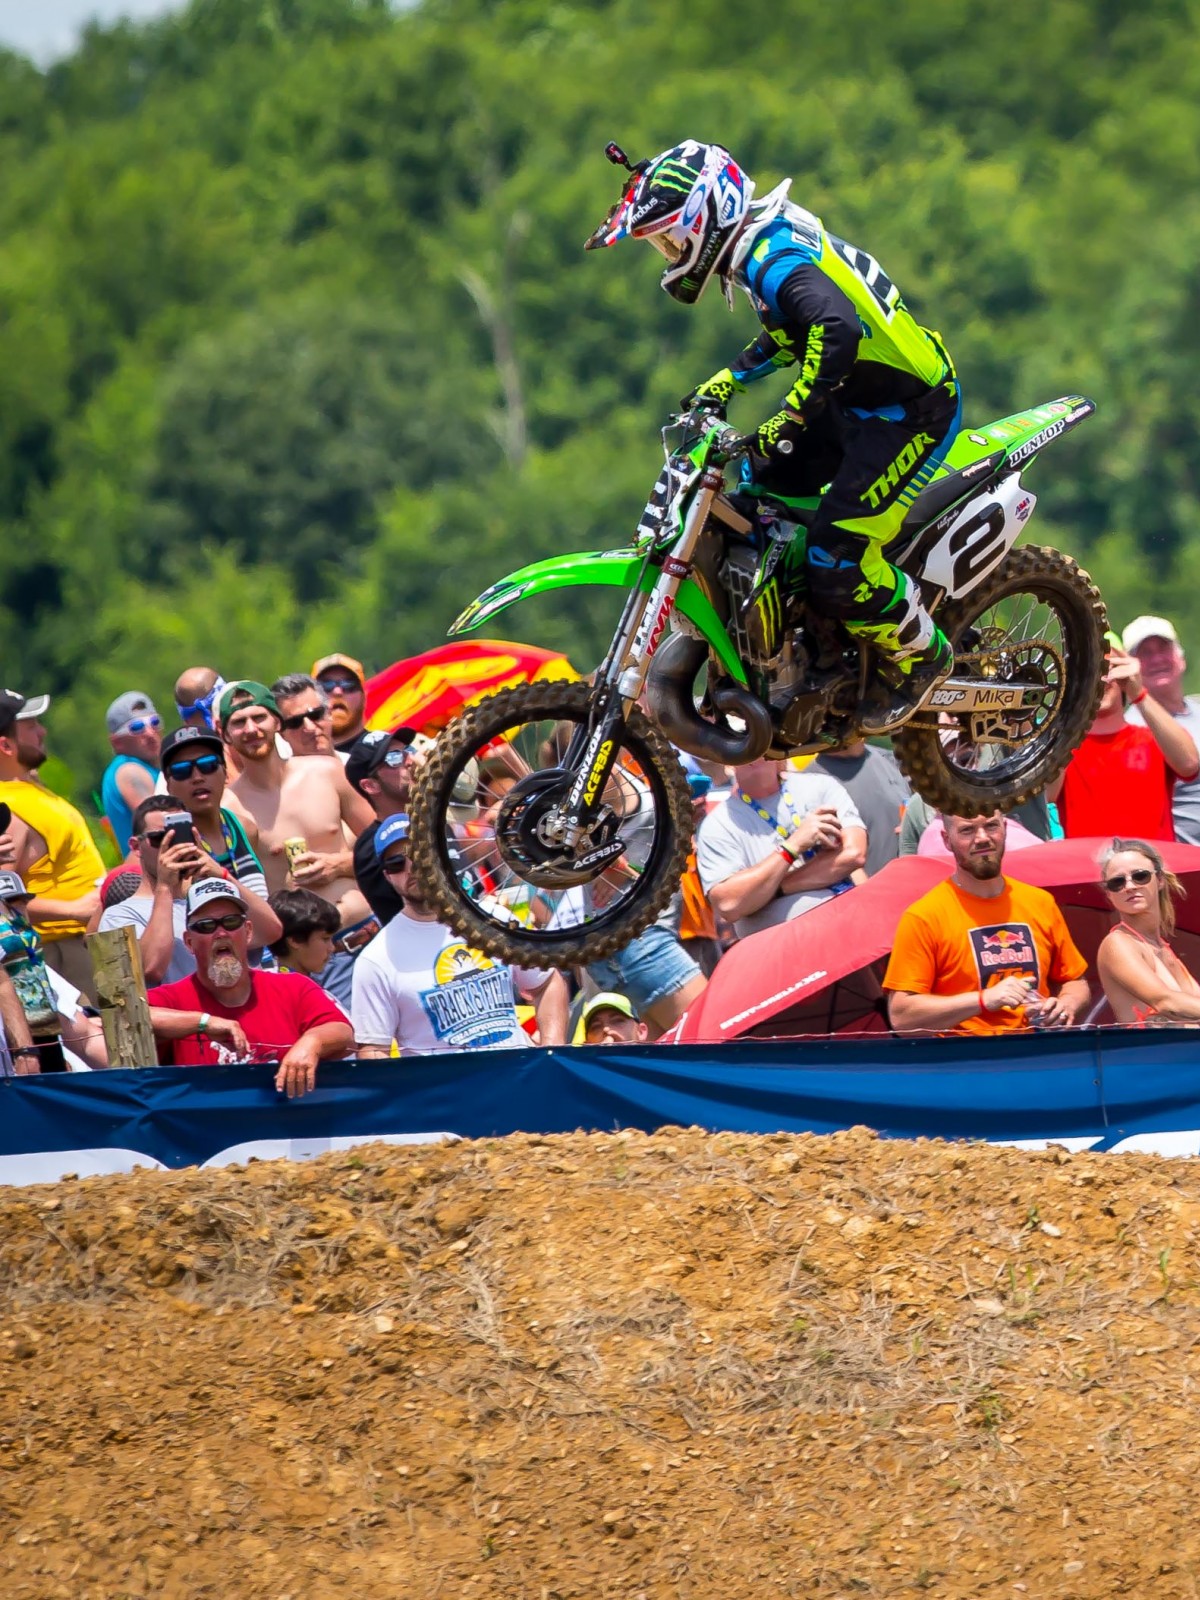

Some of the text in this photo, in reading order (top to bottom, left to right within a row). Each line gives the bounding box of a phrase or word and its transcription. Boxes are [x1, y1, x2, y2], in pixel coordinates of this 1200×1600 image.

[631, 196, 658, 224] mobius
[1009, 420, 1066, 468] DUNLOP
[859, 431, 936, 509] THOR
[949, 502, 1006, 593] 2
[973, 690, 1015, 708] Mika
[583, 740, 613, 807] ACERBIS
[573, 842, 622, 870] ACERBIS
[428, 983, 476, 1031] TRACK
